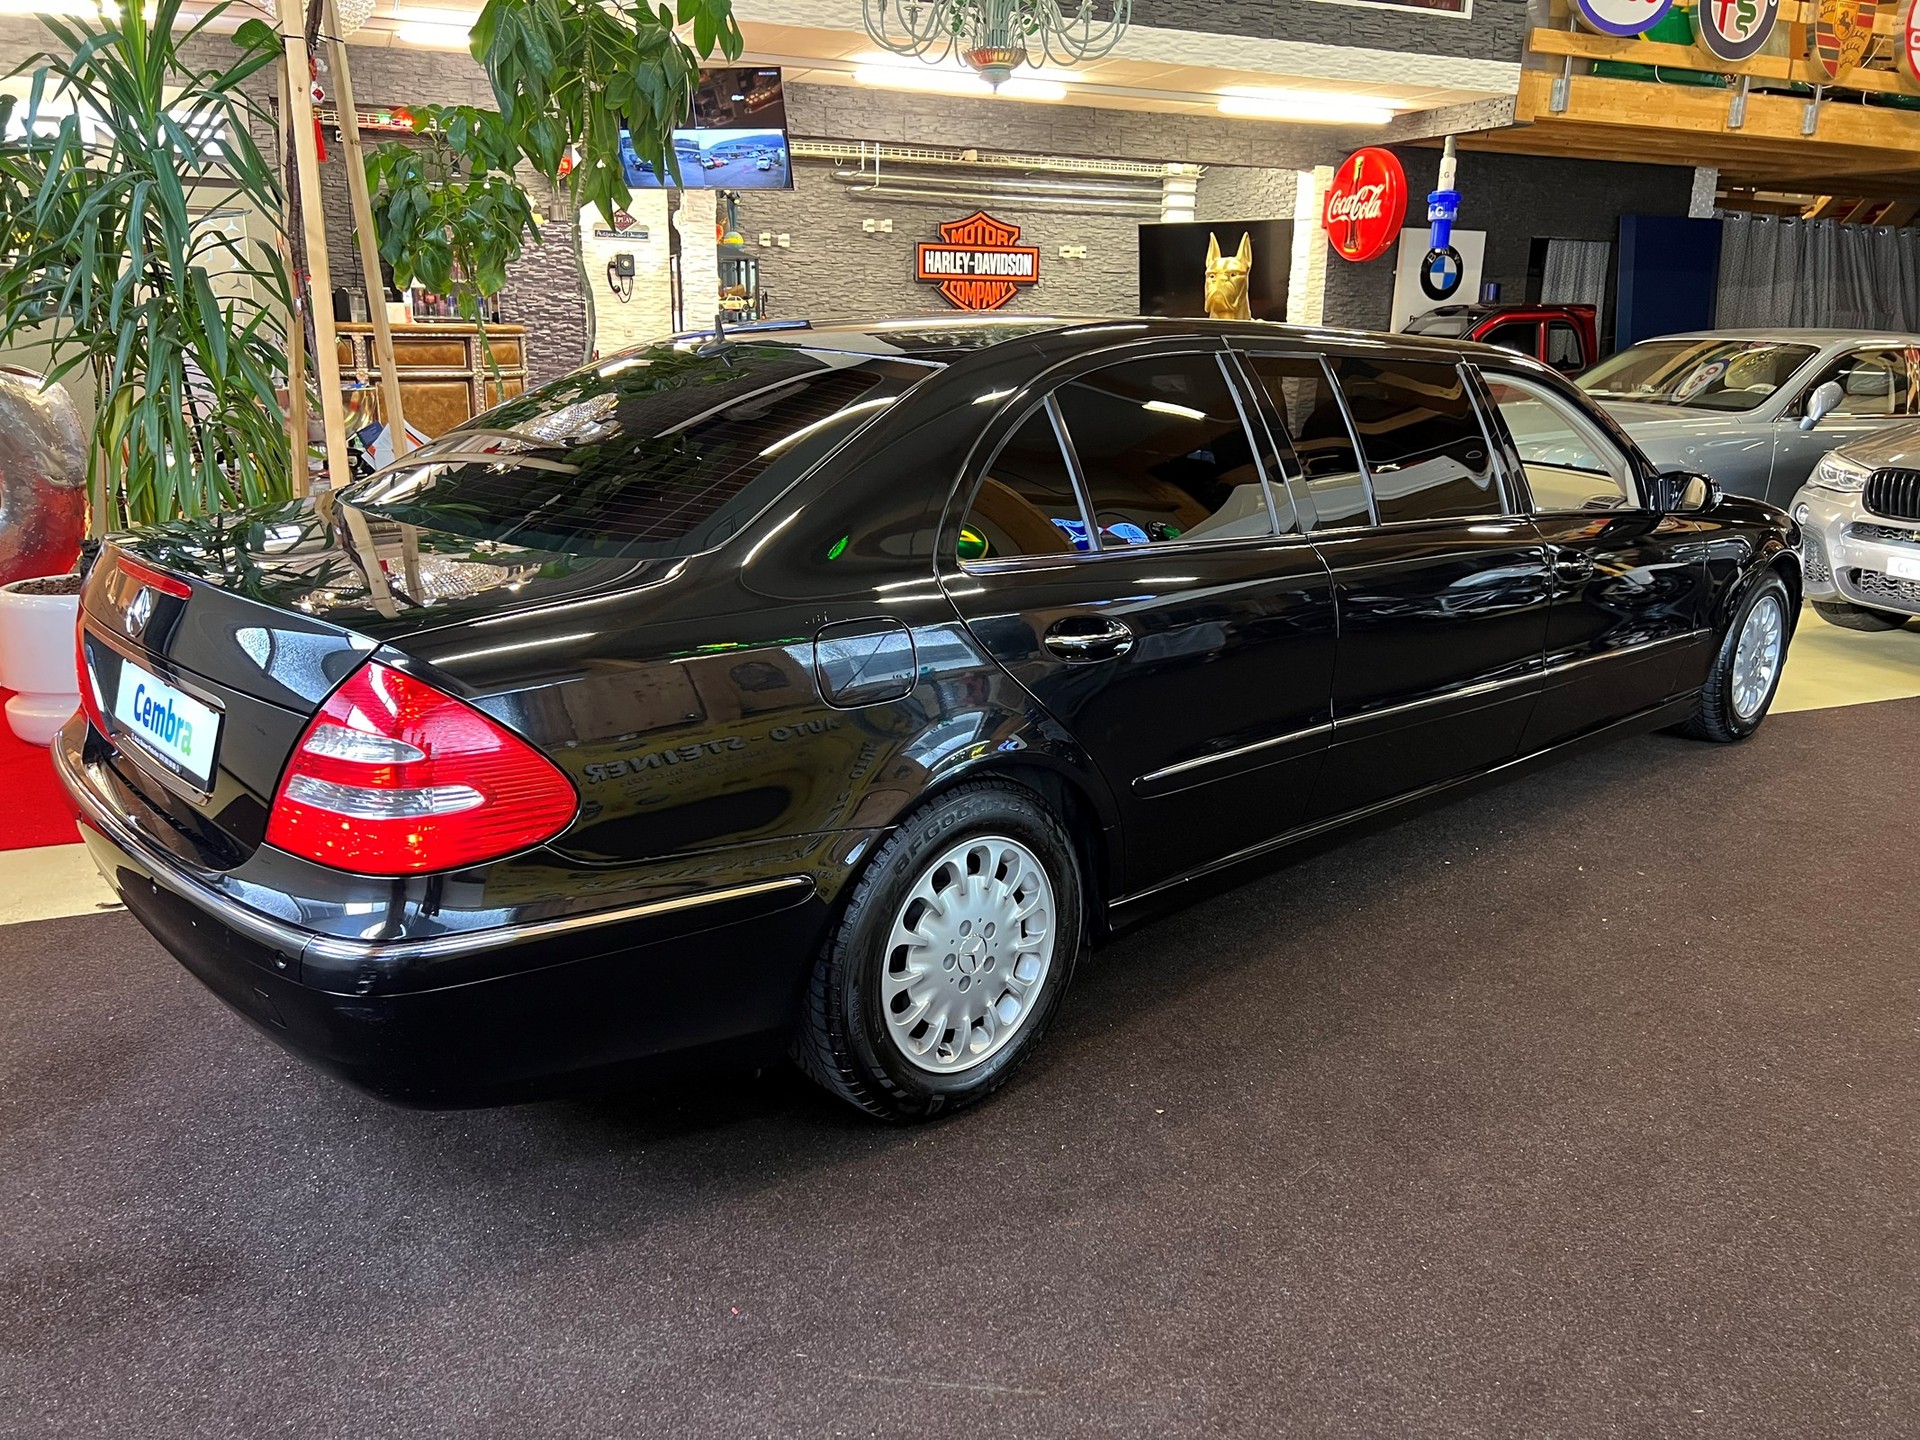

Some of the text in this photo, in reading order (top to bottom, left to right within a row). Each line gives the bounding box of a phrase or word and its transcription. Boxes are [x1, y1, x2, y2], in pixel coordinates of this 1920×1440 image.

[951, 219, 1009, 246] MOTOR
[925, 250, 1033, 276] HARLEY-DAVIDSON
[949, 280, 1008, 309] COMPANY
[133, 683, 193, 756] Cembra
